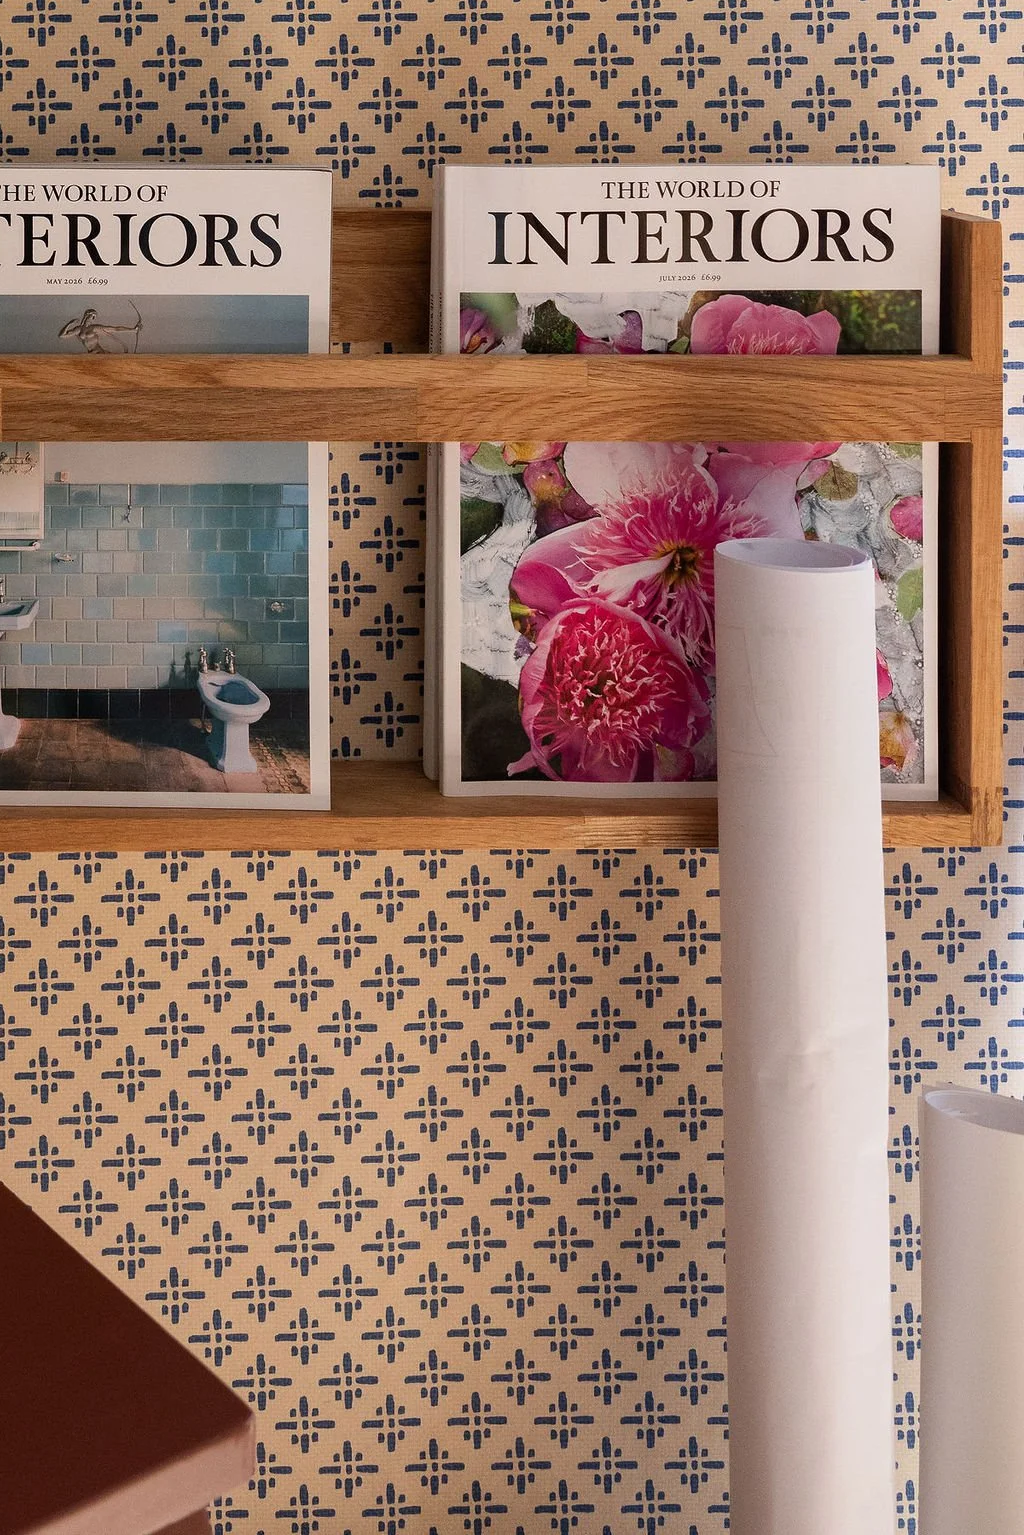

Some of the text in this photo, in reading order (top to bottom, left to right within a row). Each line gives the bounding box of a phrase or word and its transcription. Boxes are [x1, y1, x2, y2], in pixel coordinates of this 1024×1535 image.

[41, 184, 132, 203] WORLD
[136, 184, 168, 203] OF
[601, 180, 781, 199] THE WORLD OF
[487, 207, 895, 266] INTERIORS
[64, 277, 83, 285] 2026
[87, 277, 109, 286] £6.99
[701, 274, 721, 282] £6.99
